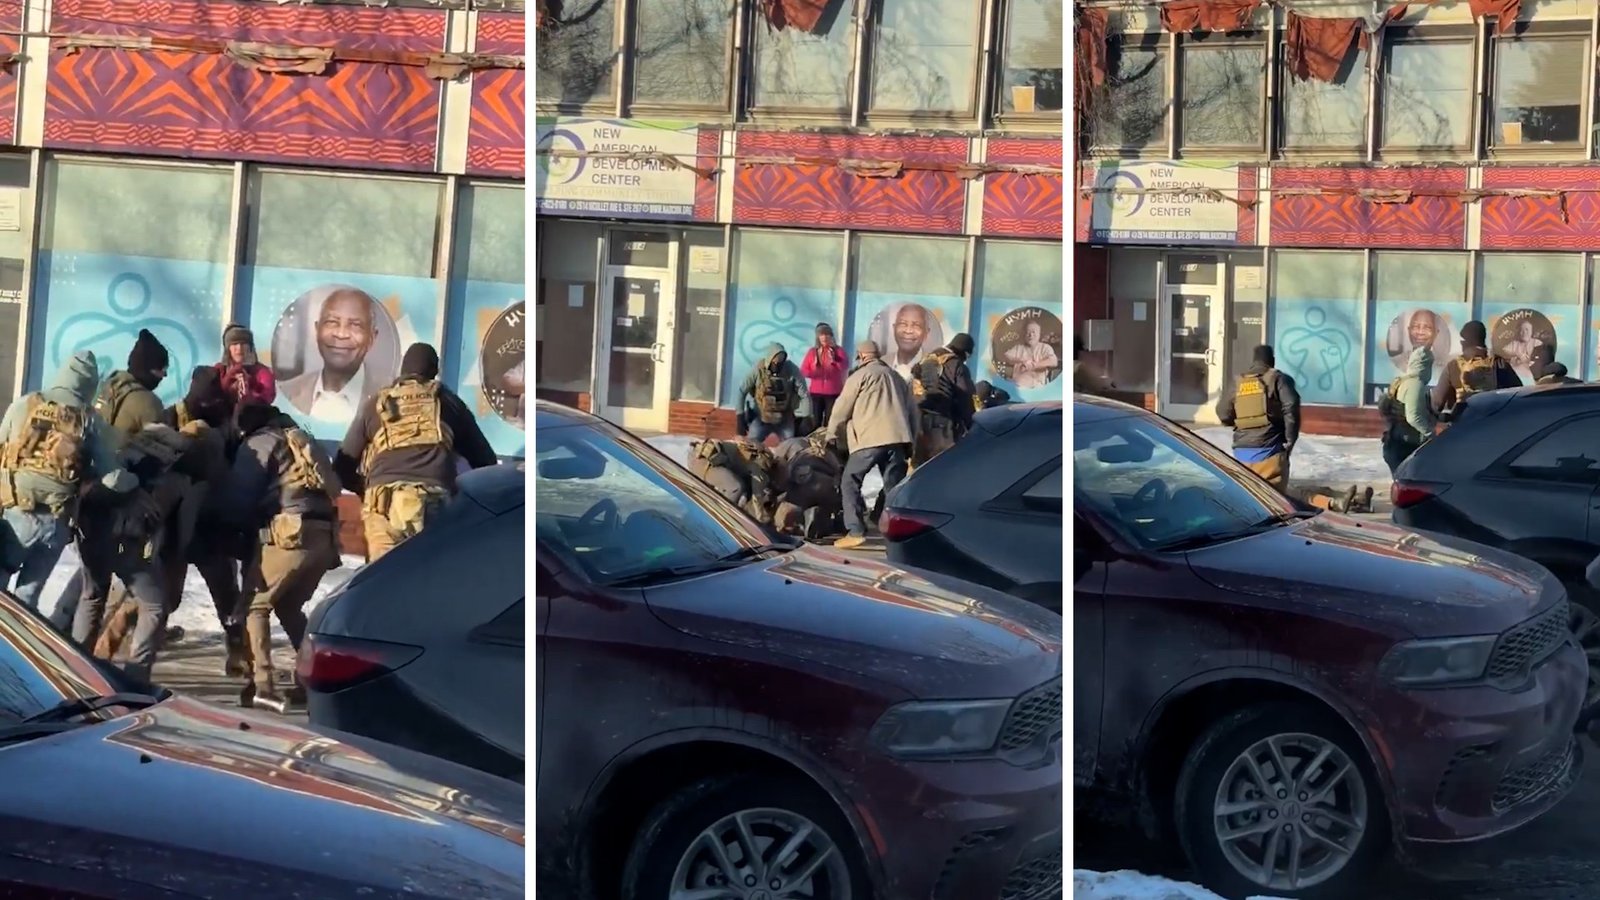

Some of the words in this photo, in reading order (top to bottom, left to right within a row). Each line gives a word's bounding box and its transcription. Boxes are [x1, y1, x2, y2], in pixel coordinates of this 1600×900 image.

[593, 128, 621, 139] NEW
[593, 143, 657, 153] AMERICAN
[592, 158, 681, 171] DEVELOPMET
[1150, 168, 1174, 178] NEW
[592, 173, 641, 186] CENTER
[1150, 181, 1205, 189] AMERICAN
[1150, 194, 1225, 204] DEVELOPMET
[1150, 207, 1191, 217] CENTER
